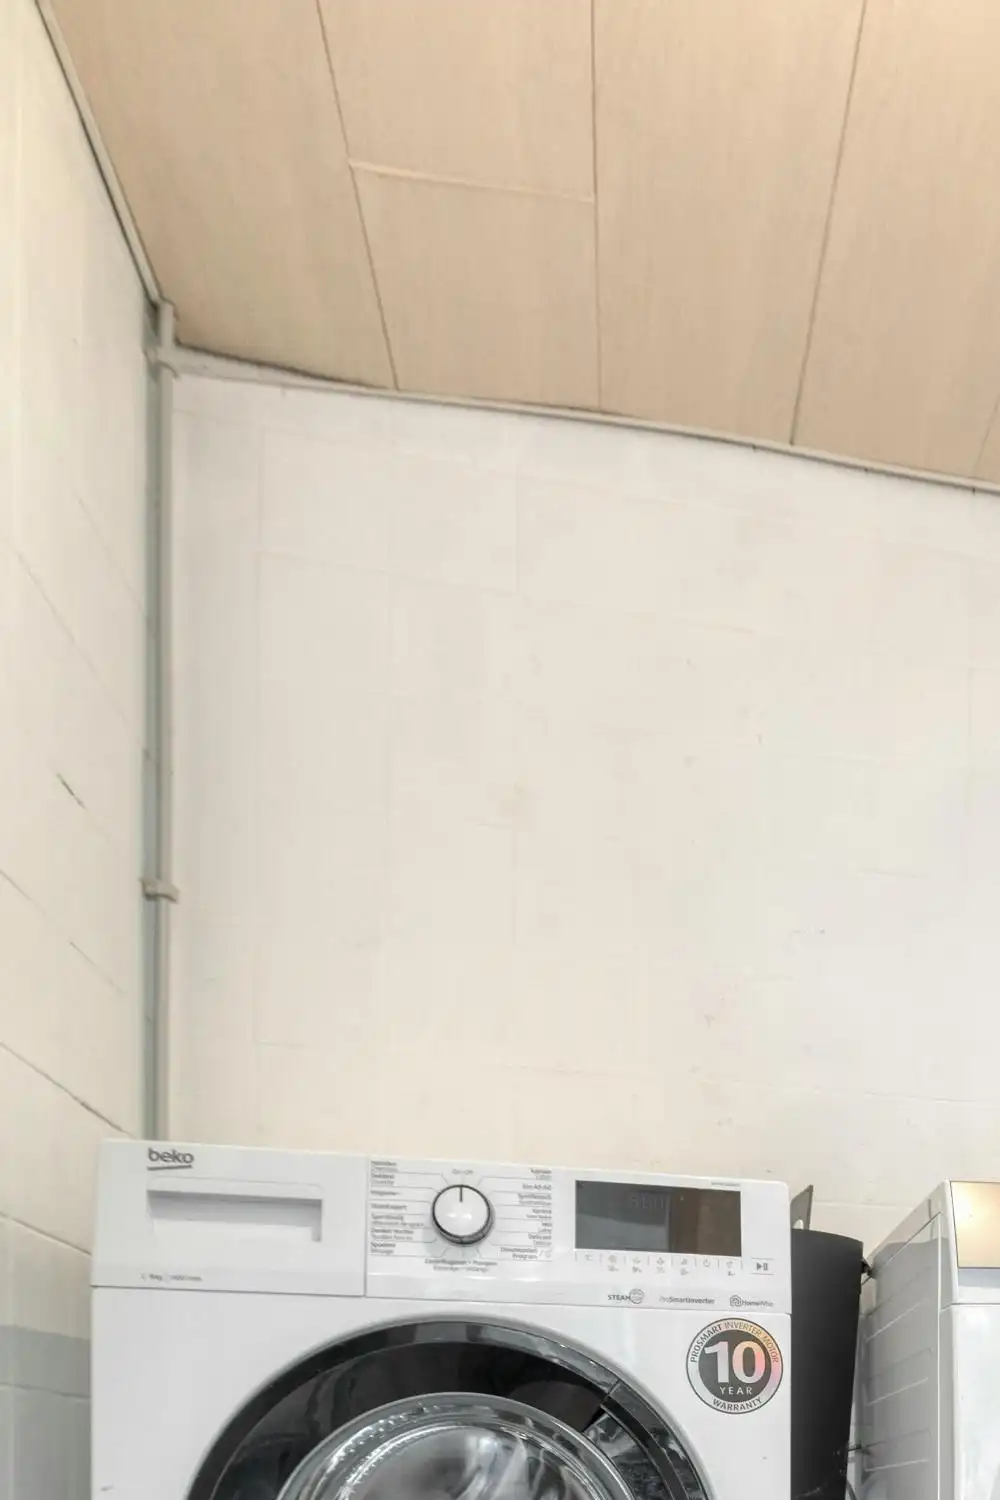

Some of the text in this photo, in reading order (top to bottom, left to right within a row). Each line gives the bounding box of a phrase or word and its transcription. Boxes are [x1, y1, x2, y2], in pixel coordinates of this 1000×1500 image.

[147, 1147, 194, 1164] beko
[690, 1321, 780, 1364] PROSMART INVERTER MOTOR
[704, 1340, 766, 1384] 10
[719, 1386, 753, 1395] YEAR
[713, 1396, 763, 1411] WARRANTY
